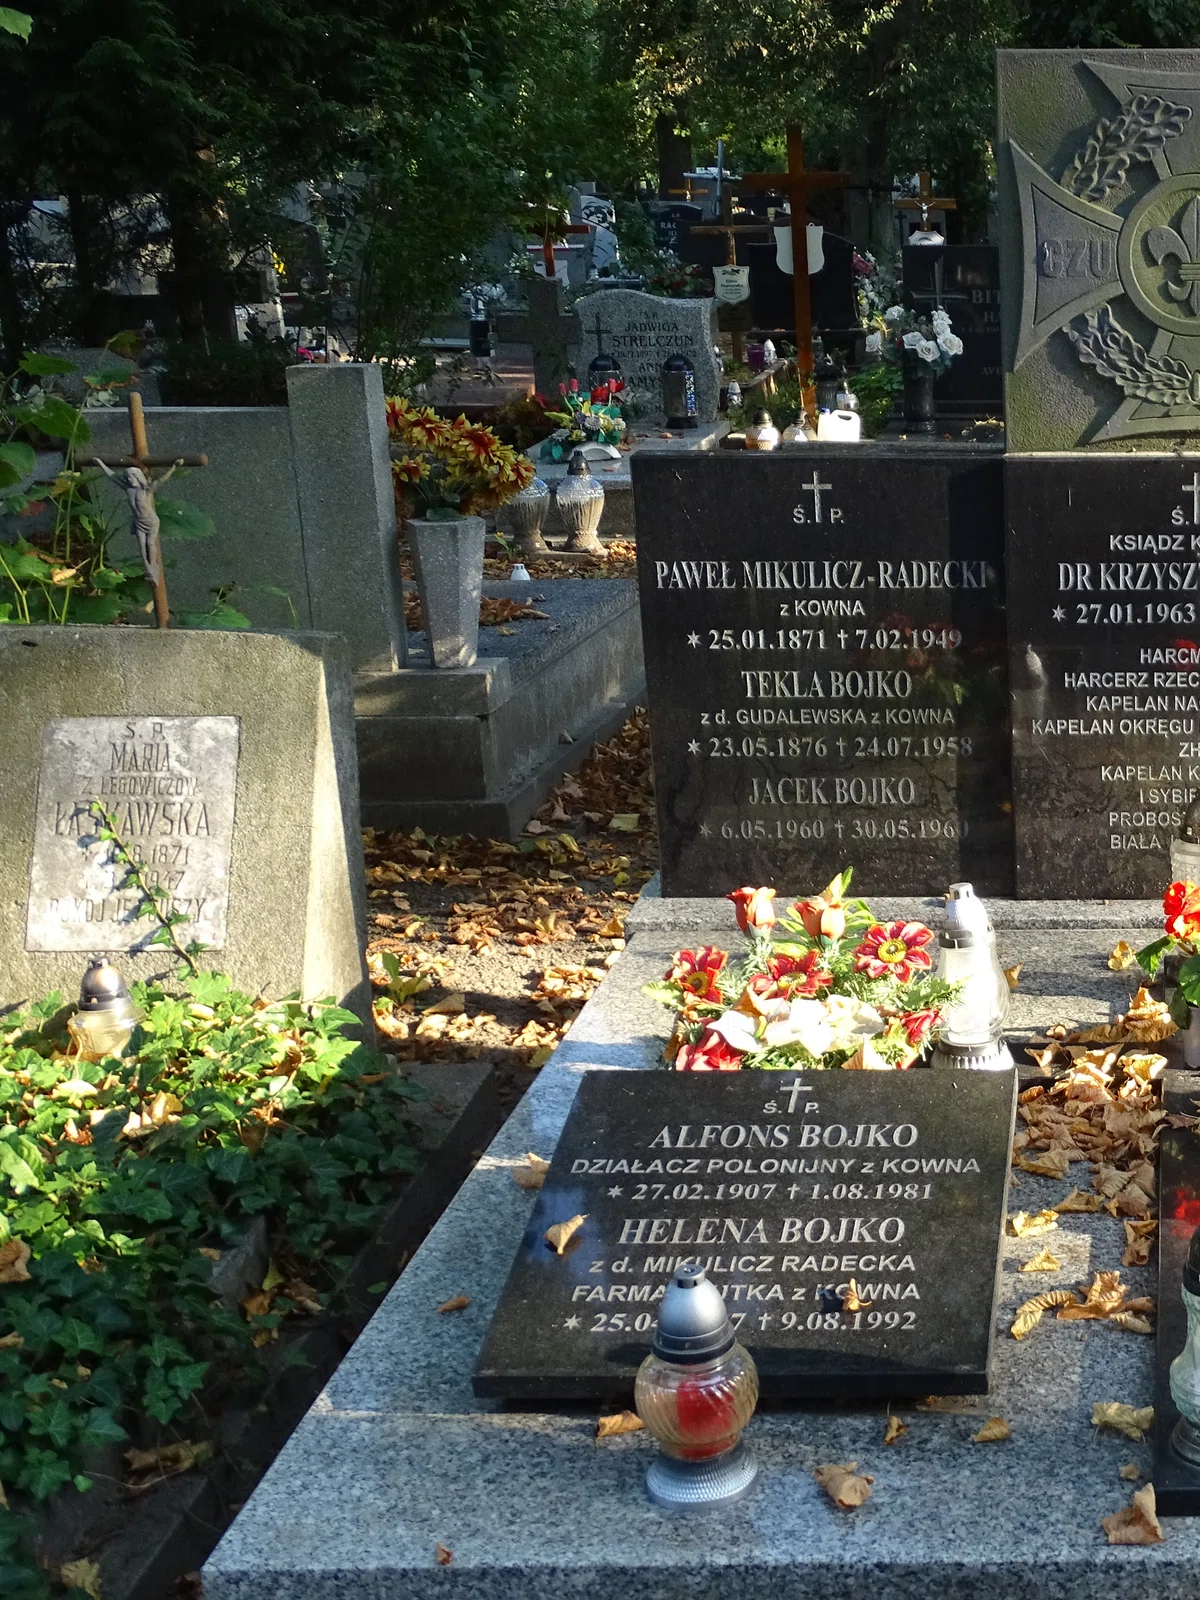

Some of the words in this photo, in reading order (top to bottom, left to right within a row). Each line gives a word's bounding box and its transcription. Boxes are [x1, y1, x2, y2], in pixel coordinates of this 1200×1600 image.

[1042, 239, 1112, 278] CZU
[640, 362, 664, 372] ANN
[1109, 534, 1185, 555] KSIĄDZ
[655, 560, 737, 589] PAWEŁ
[1058, 562, 1093, 591] DR
[779, 602, 789, 616] z
[794, 599, 866, 617] KOWNA
[1076, 603, 1196, 625] 27.01.1963
[708, 628, 827, 650] 25.01.1871
[855, 628, 963, 649] 7.02.1949
[741, 670, 828, 699] TEKLA
[830, 669, 912, 698] BOJKO
[1064, 672, 1148, 688] HARCERZ
[1086, 696, 1168, 711] KAPELAN
[701, 711, 710, 725] z
[715, 708, 731, 725] d.
[737, 708, 866, 725] GUDALEWSKA
[871, 711, 880, 725] z
[886, 708, 955, 725] KOWNA
[1032, 719, 1114, 735] KAPELAN
[1119, 718, 1194, 739] OKRĘGU
[111, 742, 171, 772] MARIA
[709, 736, 828, 758] 23.05.1876
[855, 736, 973, 757] 24.07.1958
[1101, 765, 1183, 781] KAPELAN
[749, 778, 830, 806] JACEK
[836, 777, 916, 805] BOJKO
[721, 818, 826, 840] 6.05.1960
[851, 818, 969, 839] 30.05.1960
[1110, 832, 1162, 849] BIAŁA
[648, 1124, 790, 1149] ALFONS
[799, 1123, 918, 1149] BOJKO
[570, 1158, 701, 1175] DZIAŁACZ
[706, 1158, 854, 1175] POLONIJNY
[861, 1163, 875, 1174] z
[882, 1158, 981, 1174] KOWNA
[631, 1183, 776, 1202] 27.02.1907
[809, 1183, 934, 1201] 1.08.1981
[617, 1218, 769, 1245] HELENA
[780, 1217, 906, 1244] BOJKO
[588, 1260, 605, 1273] z
[611, 1256, 634, 1273] d.
[643, 1255, 773, 1273] MIKULICZ
[781, 1255, 916, 1273] RADECKA
[571, 1283, 785, 1302] FARMAUTKA
[791, 1287, 807, 1301] z
[815, 1283, 921, 1300] KOWNA
[779, 1311, 917, 1331] 9.08.1992
